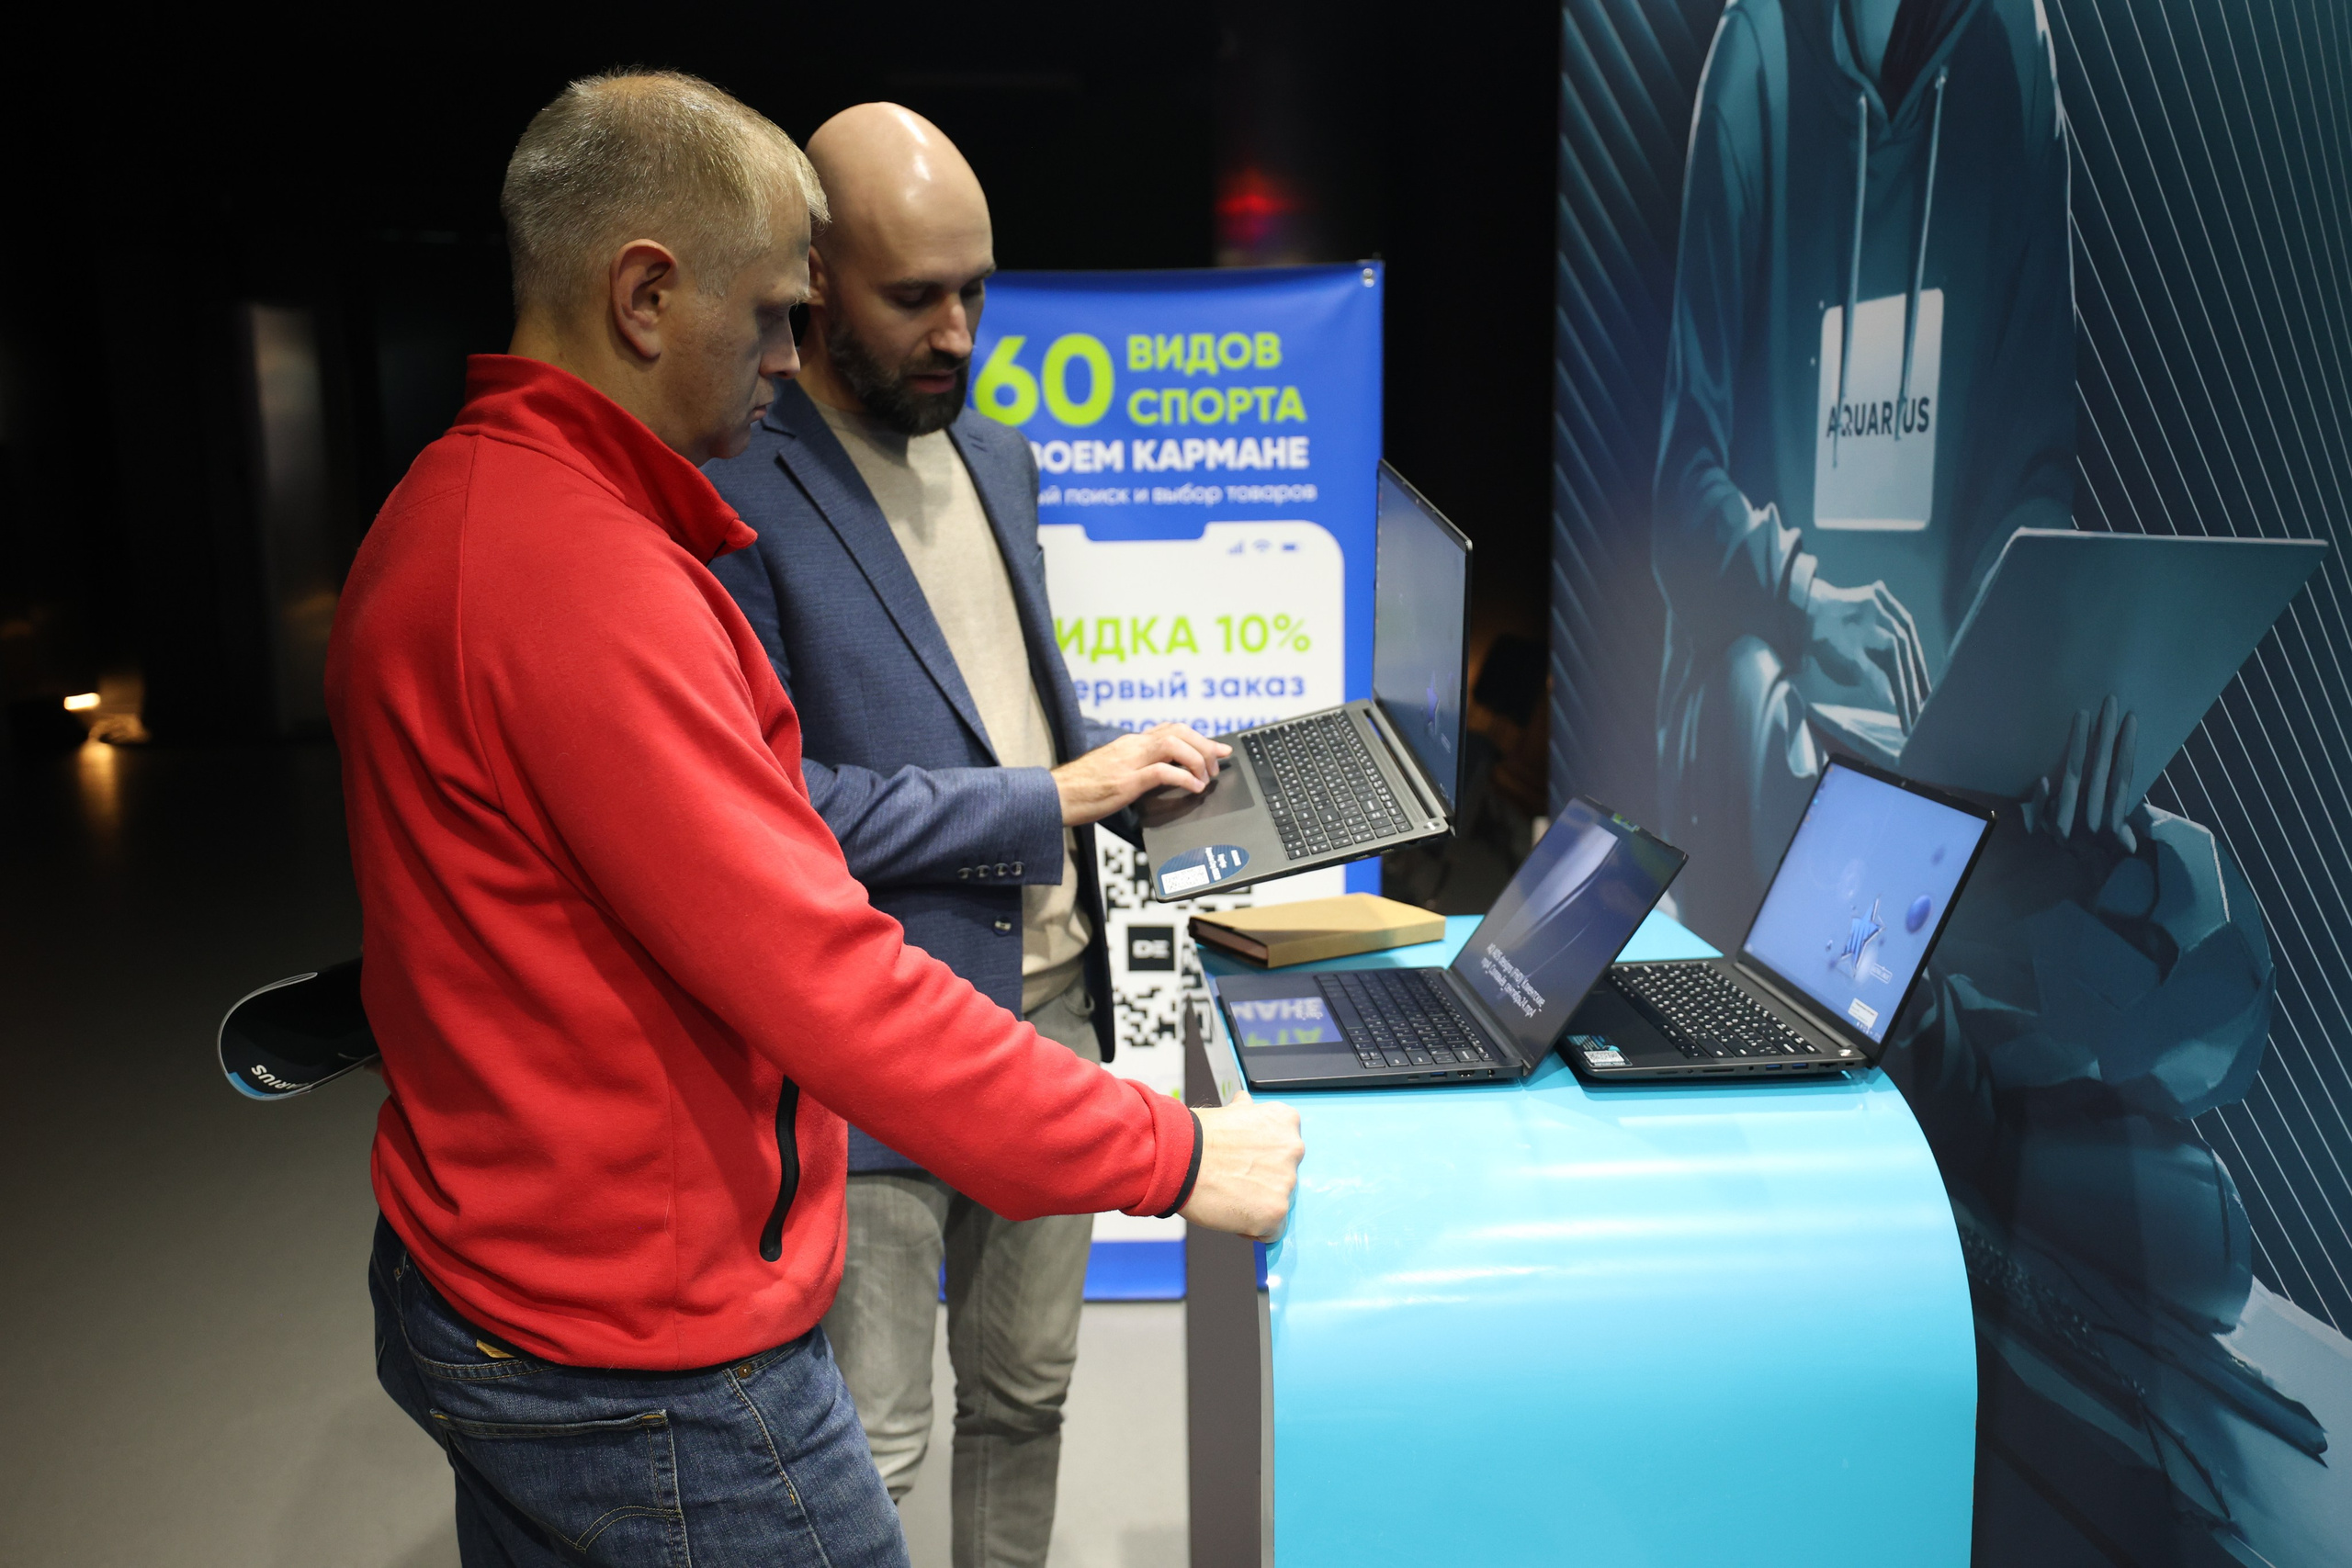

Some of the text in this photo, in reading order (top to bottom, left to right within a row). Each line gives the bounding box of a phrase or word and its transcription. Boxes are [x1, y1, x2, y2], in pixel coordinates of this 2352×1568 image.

[1126, 332, 1283, 376] ВИДОВ
[973, 333, 1114, 427] 60
[1126, 386, 1307, 426] СПОРТА
[1826, 396, 1930, 438] AQUARUS
[1131, 436, 1310, 472] КАРМАНЕ
[1064, 487, 1131, 507] поиск
[1132, 487, 1150, 505] и
[1151, 481, 1224, 508] выбор
[1225, 483, 1318, 507] товаров
[1056, 613, 1311, 663] ИДКА 10%
[1073, 671, 1306, 706] ервый заказ
